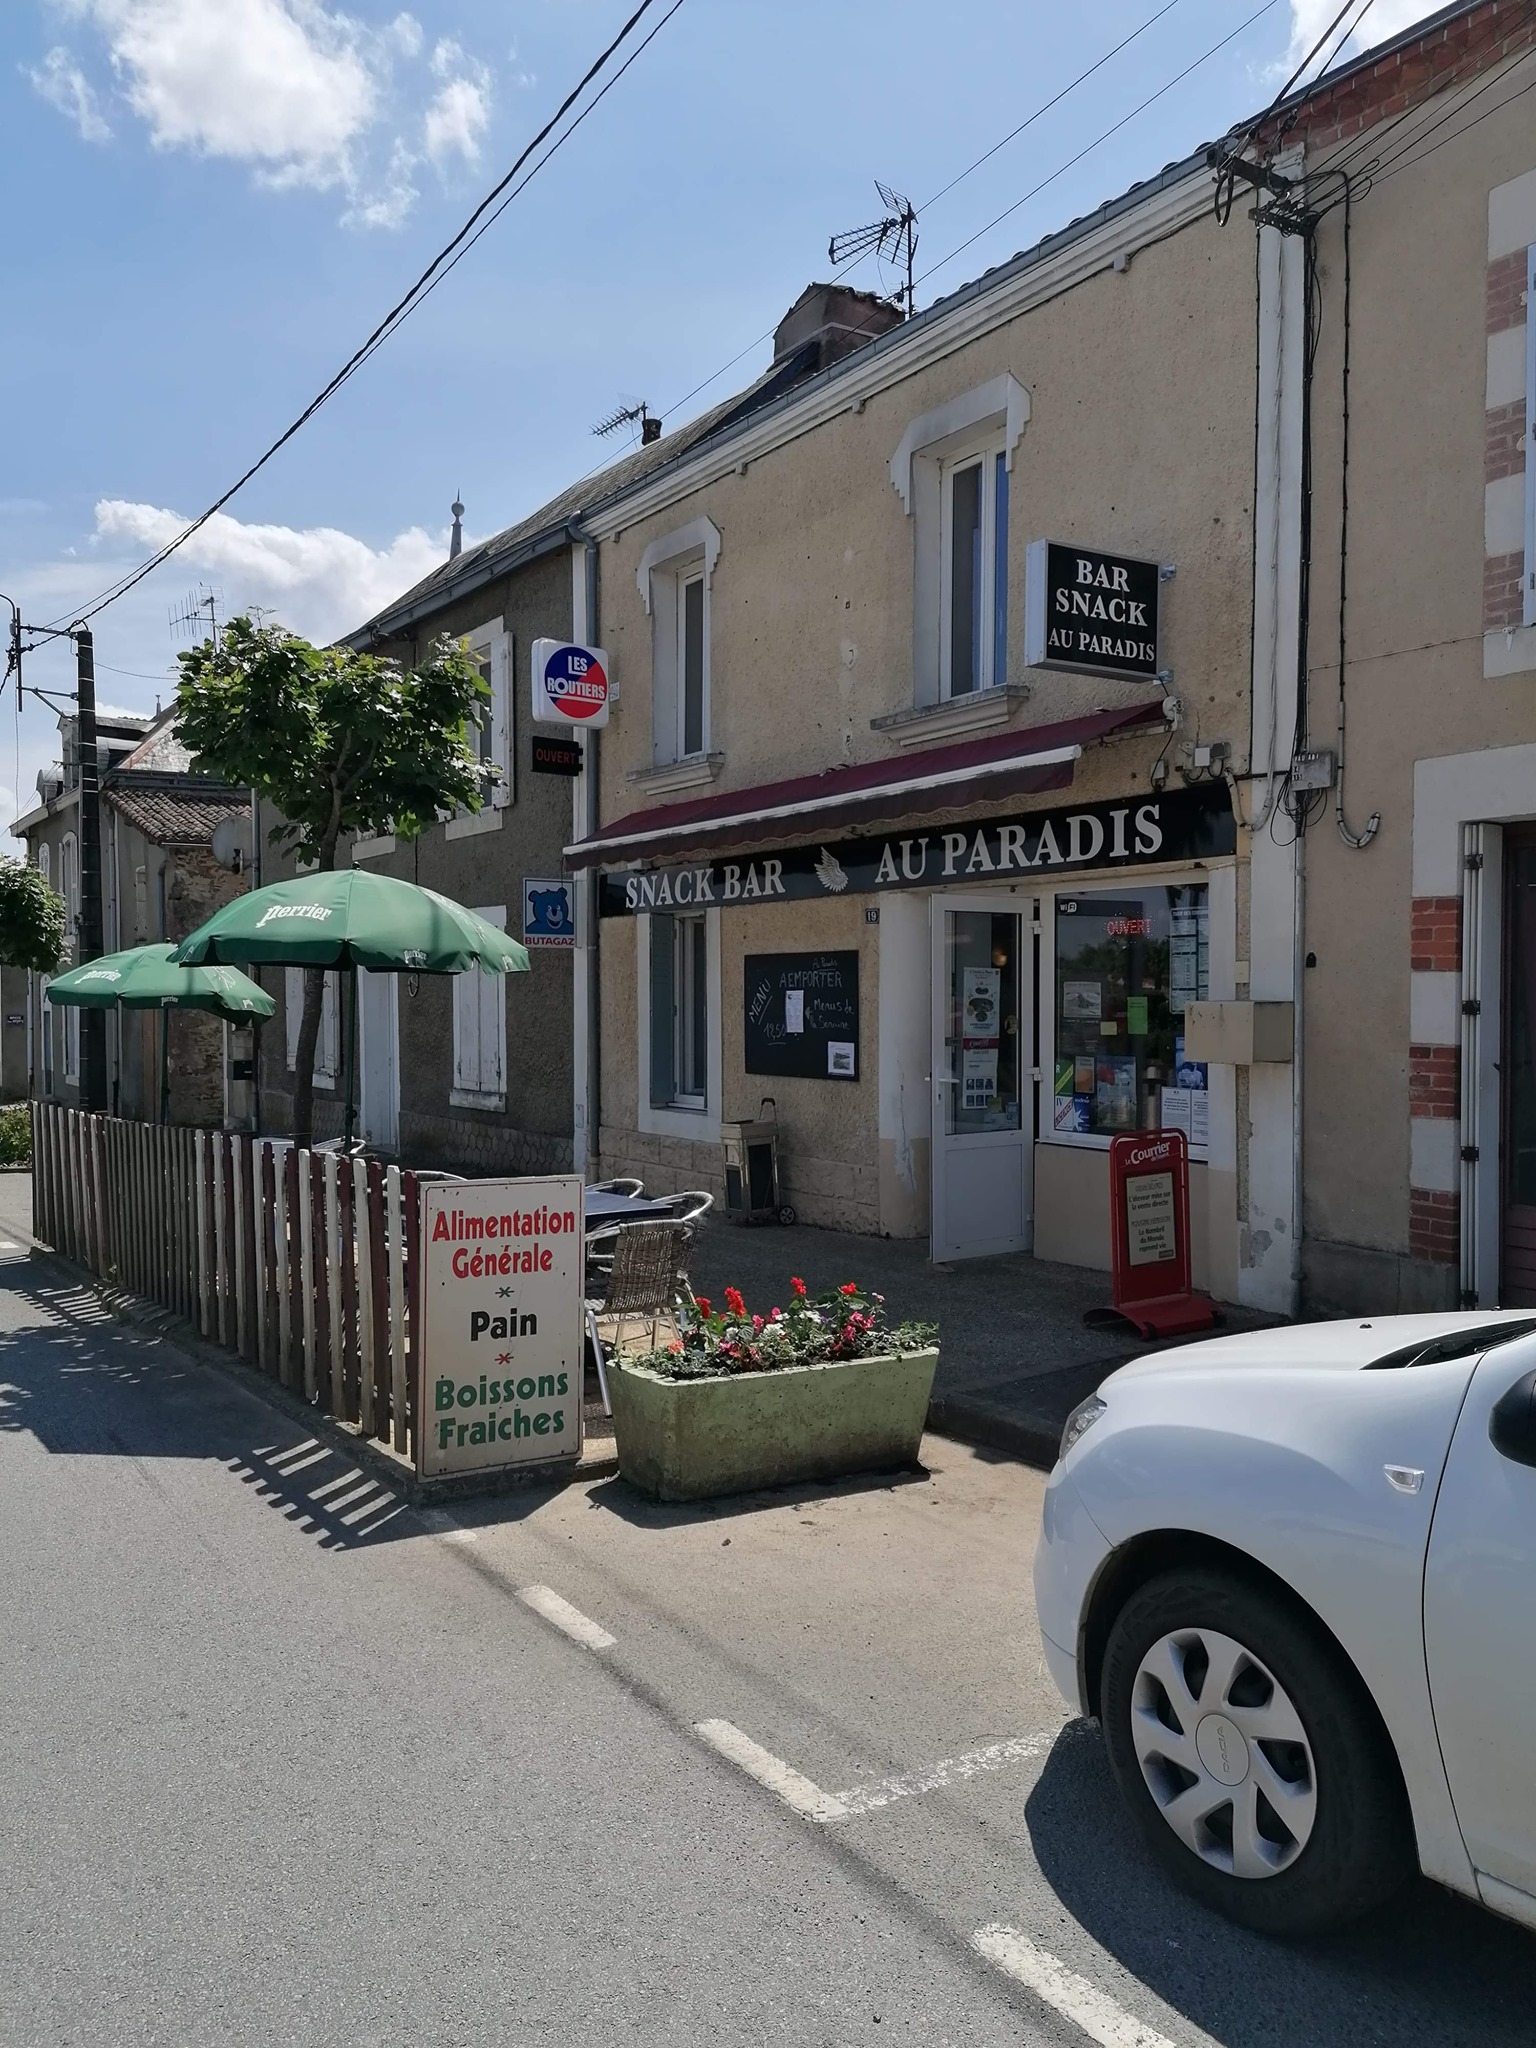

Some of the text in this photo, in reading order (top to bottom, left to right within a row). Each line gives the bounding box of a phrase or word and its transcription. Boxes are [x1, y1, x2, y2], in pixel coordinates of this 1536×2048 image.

[1076, 559, 1130, 592] BAR
[1056, 588, 1148, 627] SNACK
[1048, 627, 1155, 661] AU PARADIS
[568, 656, 587, 676] LES
[547, 677, 605, 699] ROUTIERS
[536, 748, 576, 764] OUVERT
[625, 804, 1163, 909] SNACK BAR AU PARADIS
[867, 911, 877, 922] 19
[1107, 918, 1151, 935] OUVERT
[524, 936, 575, 947] BUTAGAZ
[748, 978, 771, 1024] MENU
[1131, 1142, 1170, 1165] Courrier
[431, 1205, 575, 1242] Alimentation
[452, 1243, 553, 1279] Générale
[470, 1307, 537, 1342] Pain
[434, 1372, 568, 1412] Boissons
[438, 1408, 564, 1450] Fraiches
[1217, 1726, 1230, 1773] DACIA
